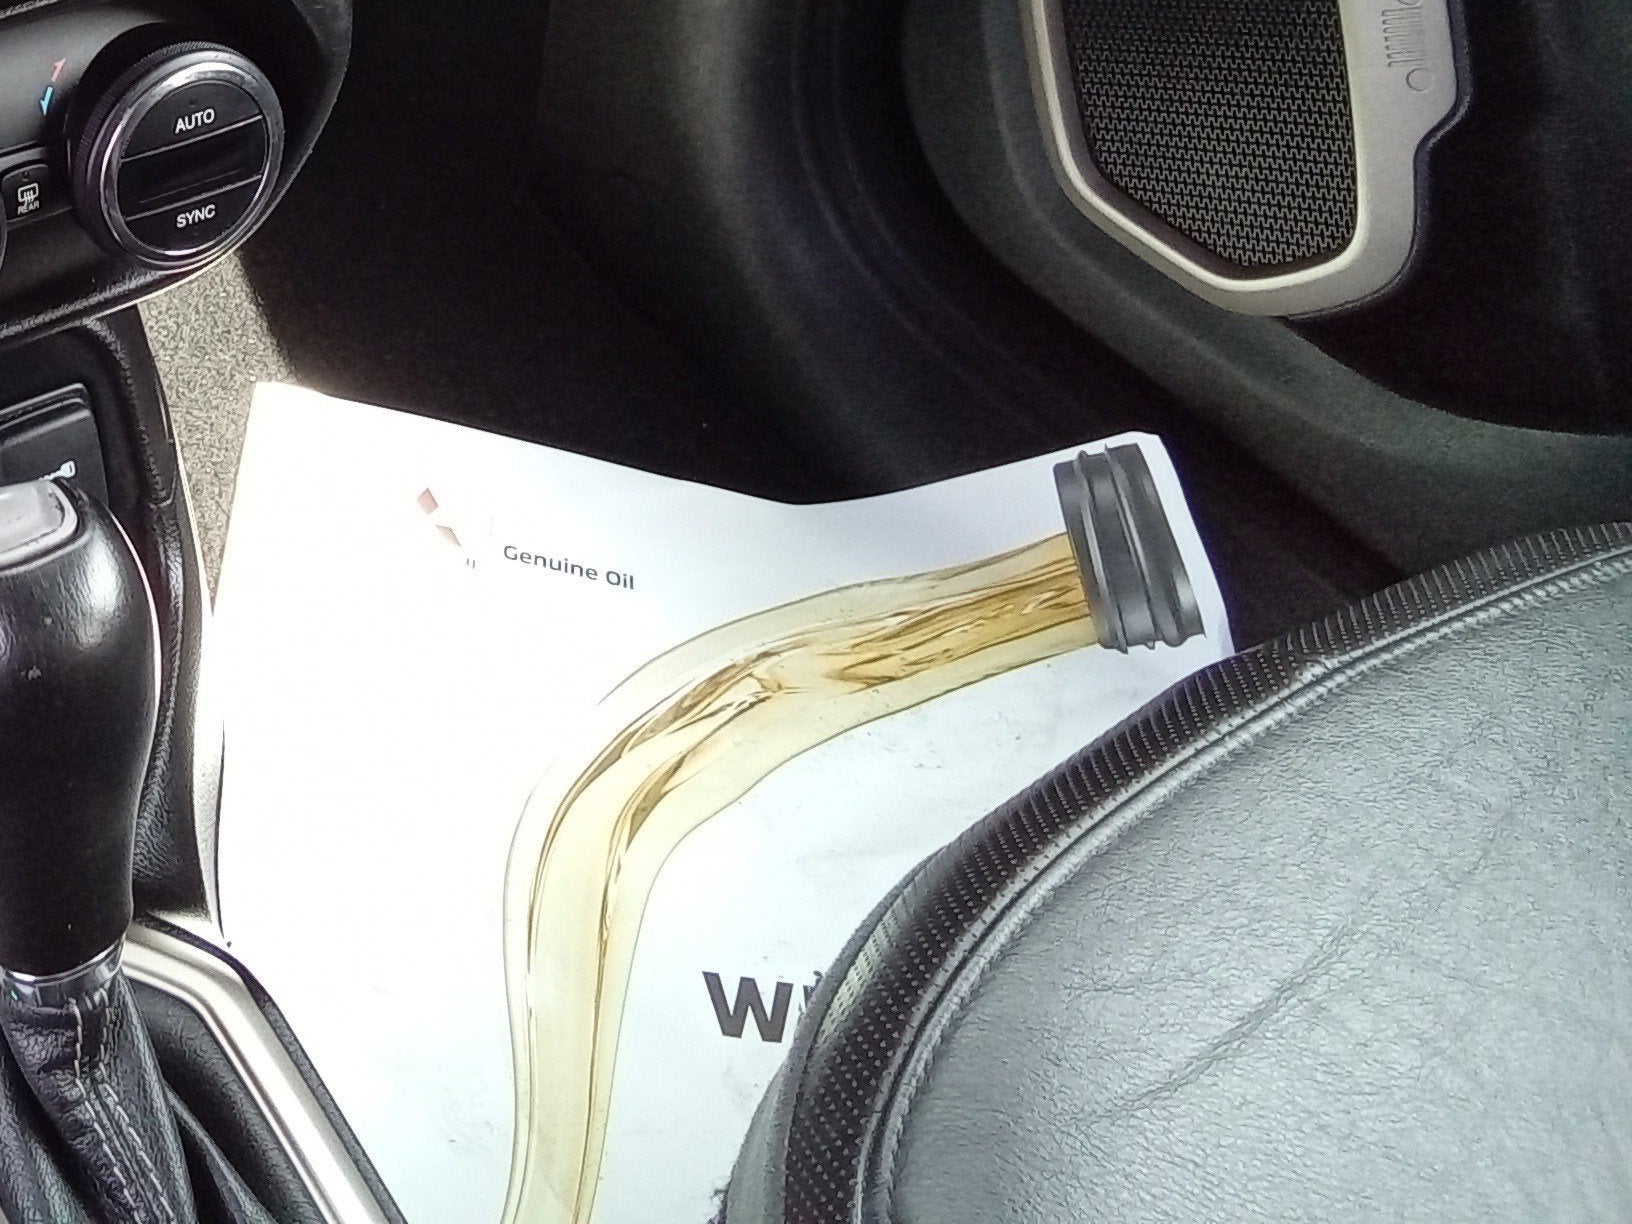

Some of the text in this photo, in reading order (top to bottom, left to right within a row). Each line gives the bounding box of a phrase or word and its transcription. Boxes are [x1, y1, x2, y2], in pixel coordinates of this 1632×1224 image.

[174, 107, 216, 134] AUTO
[176, 204, 216, 229] SYNC
[503, 545, 635, 590] Genuine Oil
